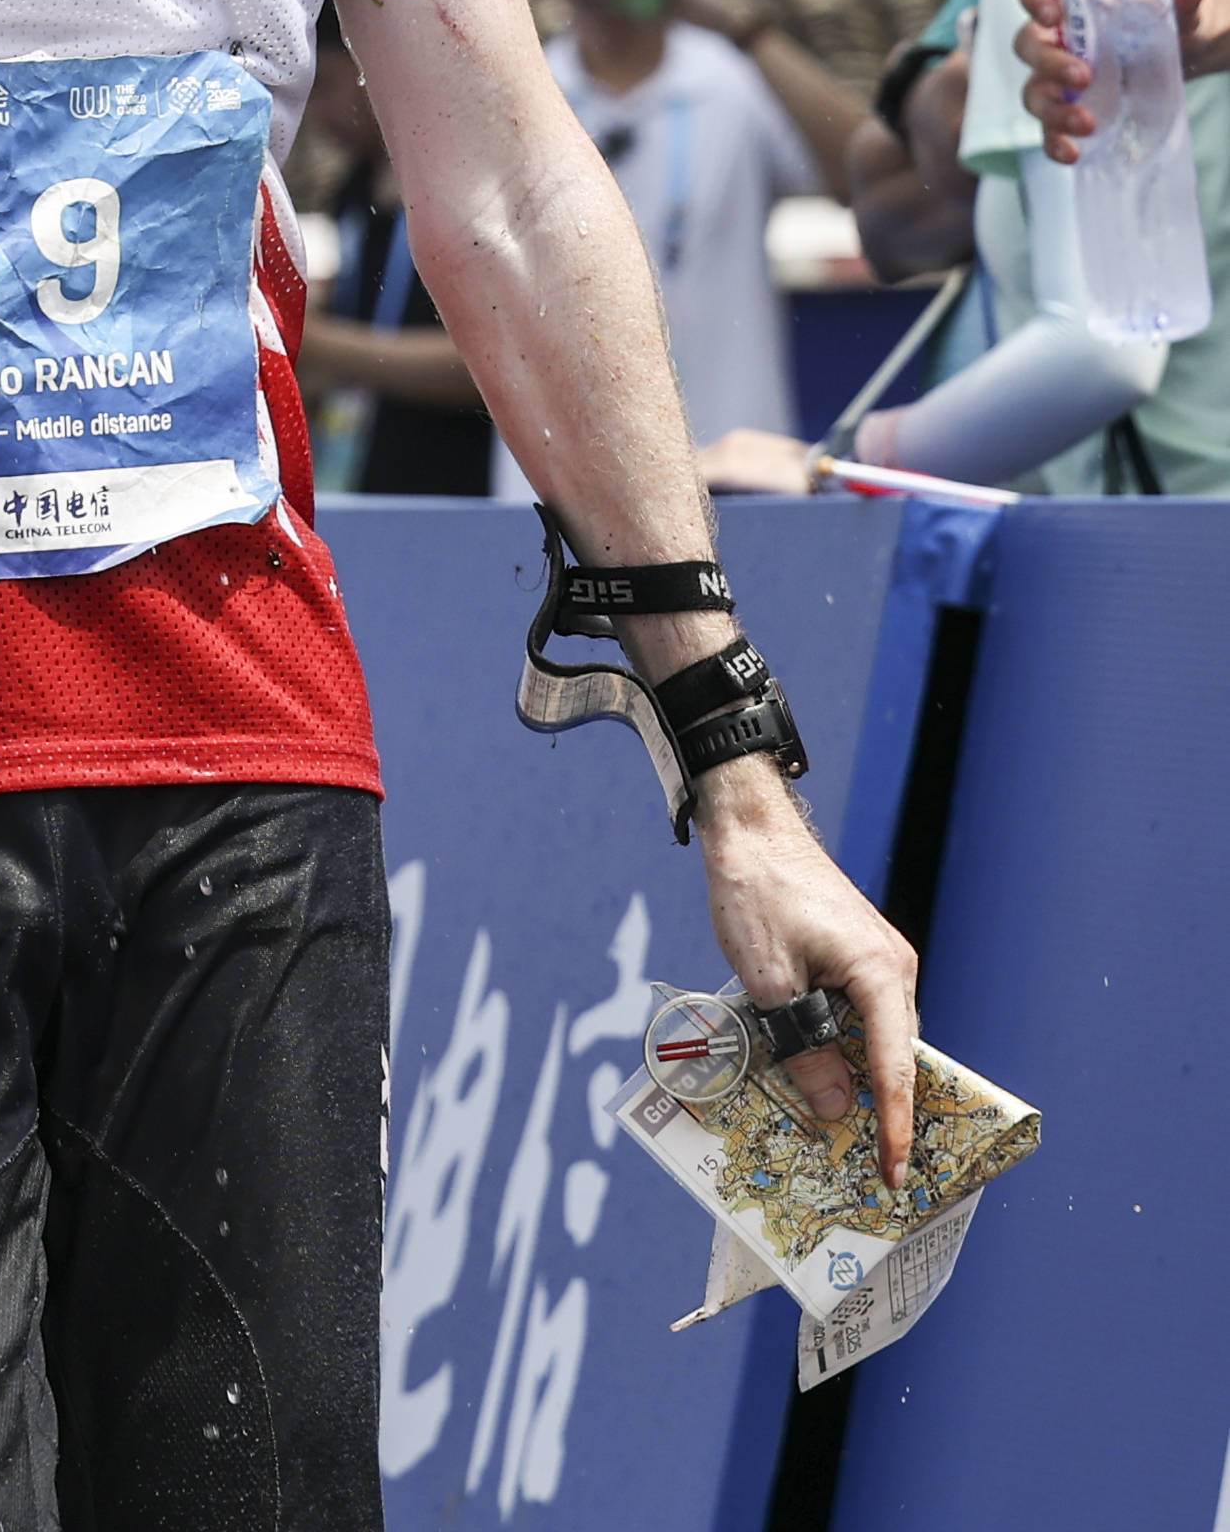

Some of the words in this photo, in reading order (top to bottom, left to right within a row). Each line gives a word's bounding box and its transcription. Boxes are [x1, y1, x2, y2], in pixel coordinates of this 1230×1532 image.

[34, 349, 174, 393] RANCAN
[16, 414, 84, 441] Middle
[91, 412, 172, 436] distance
[3, 485, 110, 527] 中国电信
[5, 526, 52, 540] CHINA
[56, 523, 112, 537] TELECOM
[697, 1154, 719, 1177] 15
[378, 888, 653, 1525] 电信
